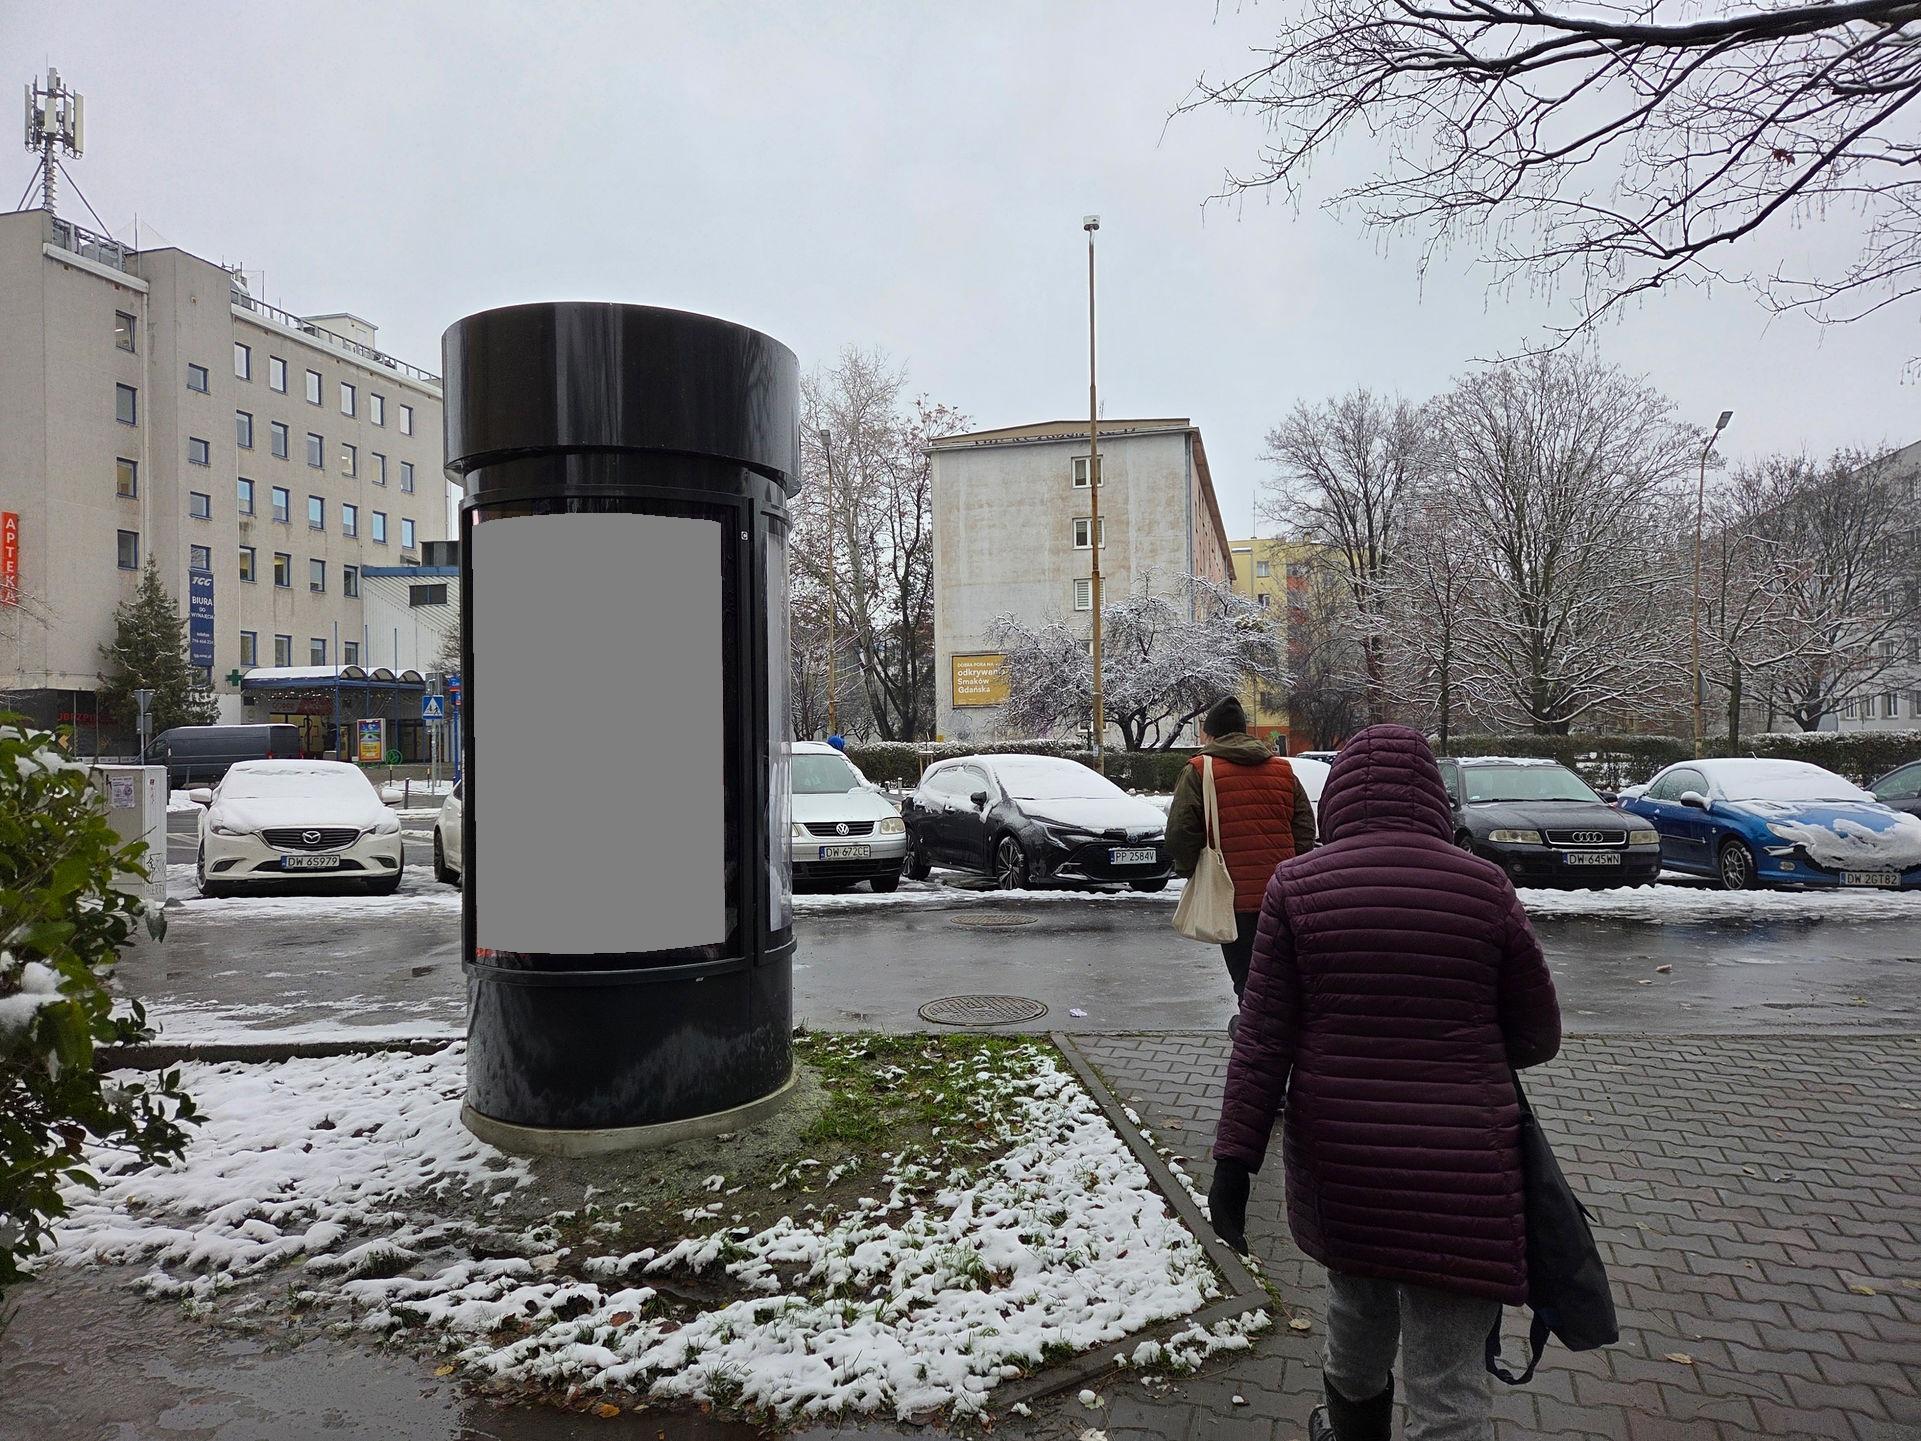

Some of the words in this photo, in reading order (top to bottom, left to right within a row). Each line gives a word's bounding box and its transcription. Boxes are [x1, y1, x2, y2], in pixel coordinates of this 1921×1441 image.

[5, 517, 17, 604] APTEKA
[192, 596, 213, 606] BIURA
[958, 668, 1008, 678] odkrywan
[958, 677, 989, 686] Smaków
[958, 685, 991, 694] Gdańska
[826, 848, 840, 857] DW
[842, 846, 869, 857] 672CE
[1116, 852, 1126, 862] PP
[1129, 851, 1154, 861] 2584V
[288, 857, 304, 866] DW
[306, 857, 338, 866] 6S979
[1569, 854, 1585, 864] DW
[1588, 854, 1620, 864] 645WN
[1847, 874, 1862, 884] DW
[1865, 873, 1898, 885] 2GT82
